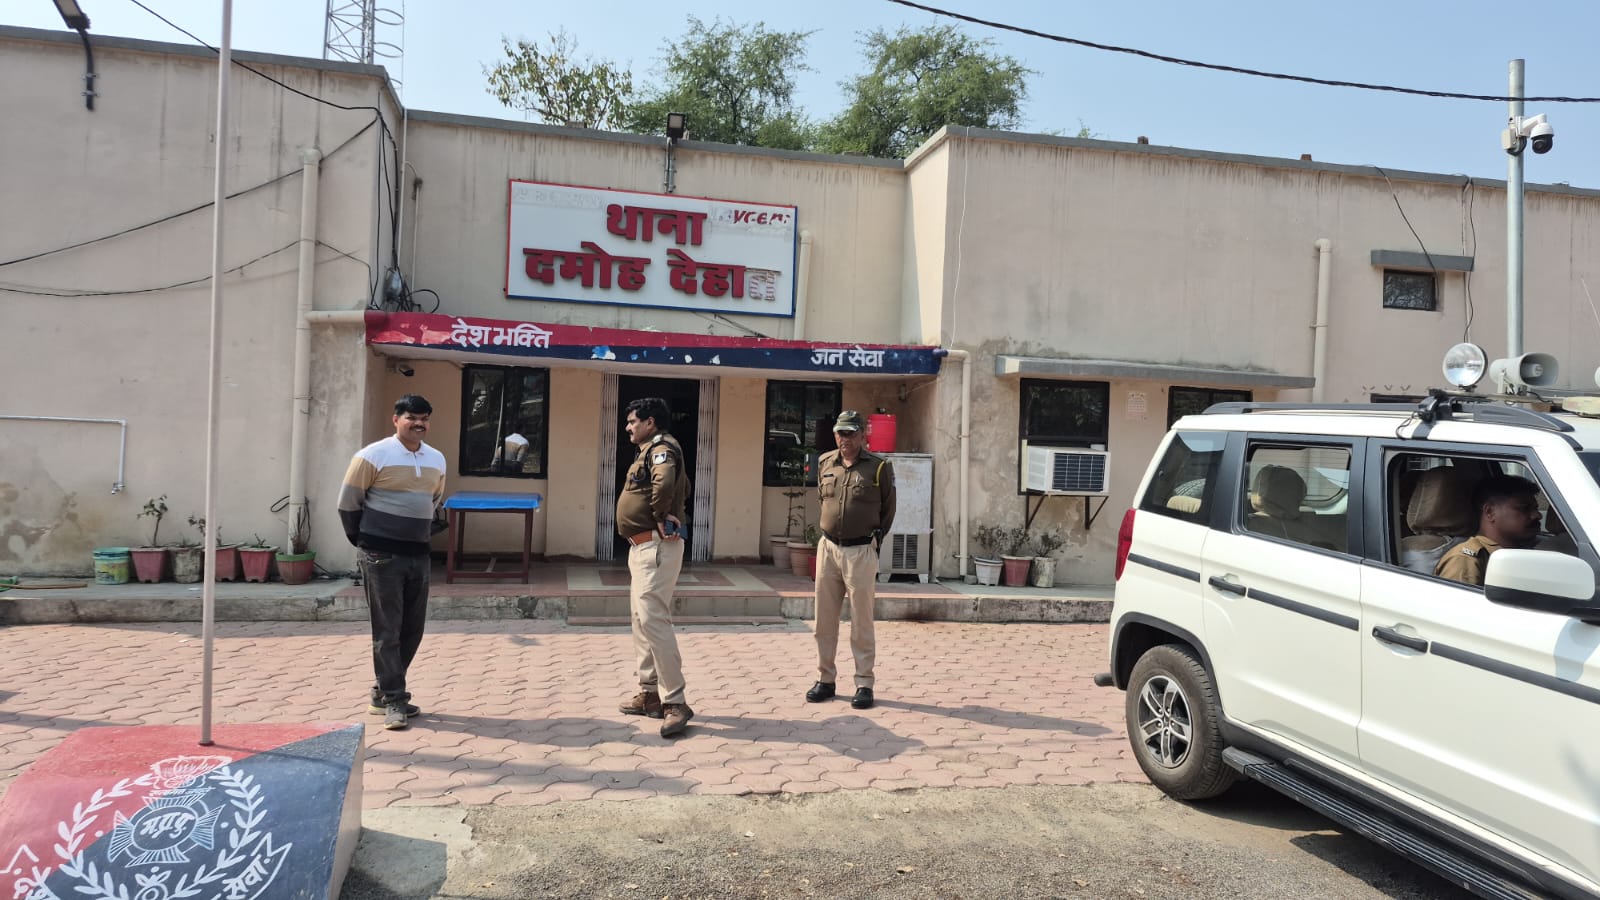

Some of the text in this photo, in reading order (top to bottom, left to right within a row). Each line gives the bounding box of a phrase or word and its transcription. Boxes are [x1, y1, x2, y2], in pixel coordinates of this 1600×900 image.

[606, 203, 708, 246] थाना
[522, 241, 782, 301] दमोह देहात
[451, 318, 553, 349] देश भक्ति
[811, 345, 885, 367] जन सेवा
